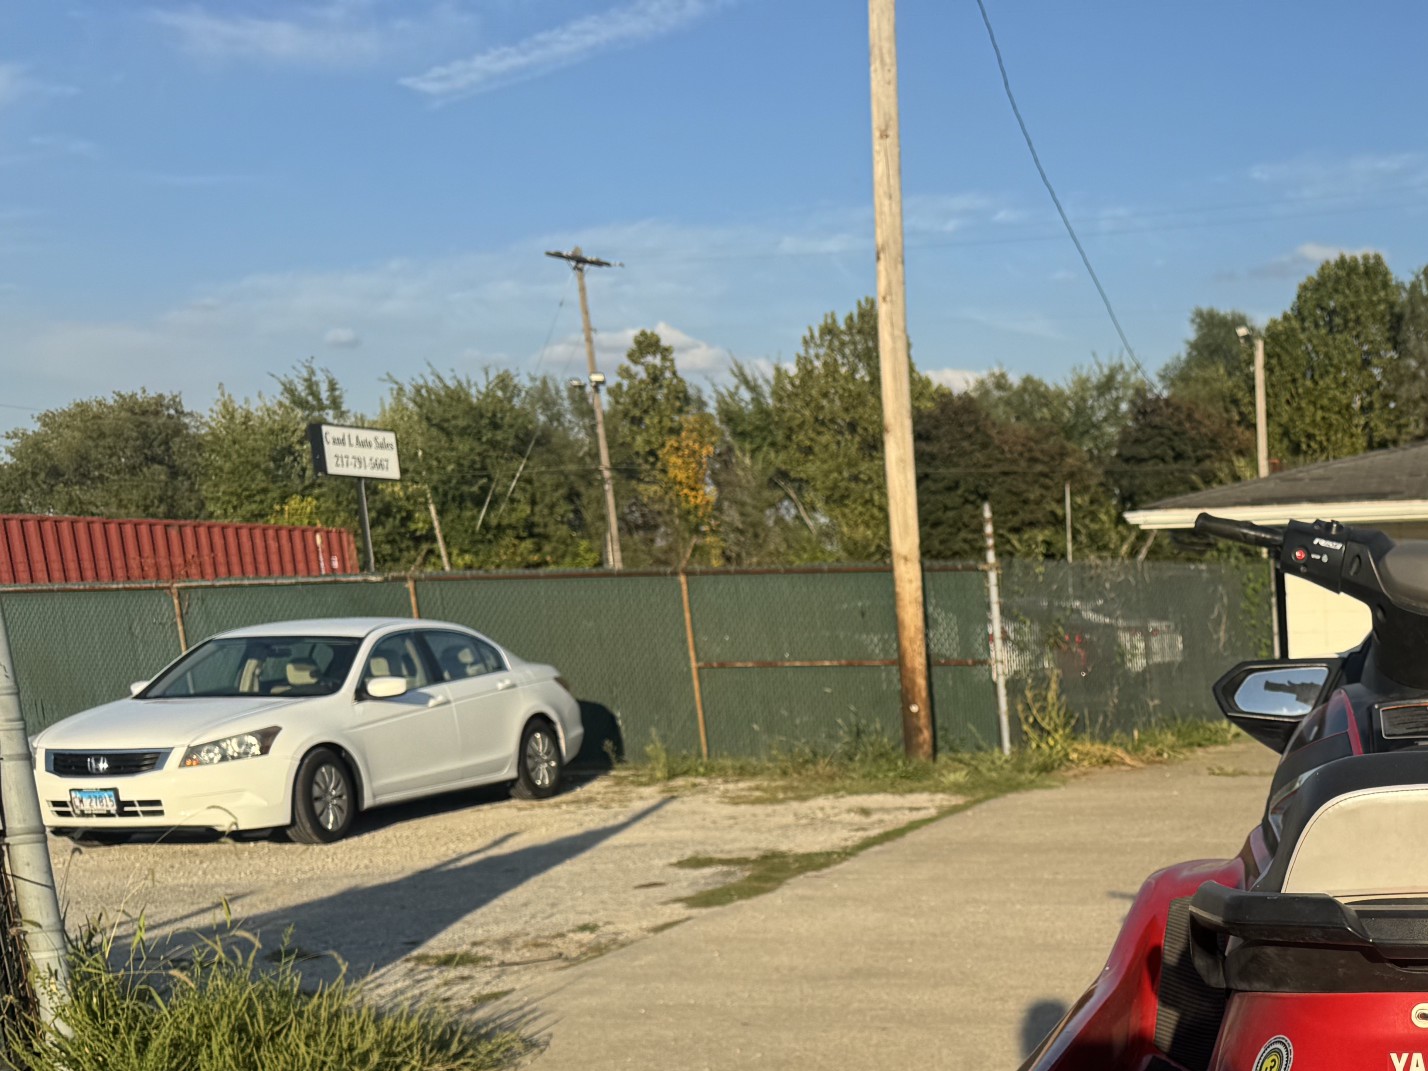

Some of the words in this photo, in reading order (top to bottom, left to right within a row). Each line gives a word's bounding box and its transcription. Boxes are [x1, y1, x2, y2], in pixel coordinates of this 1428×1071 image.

[325, 432, 330, 445] C
[332, 433, 346, 447] and
[348, 433, 355, 447] L
[356, 435, 373, 449] Auto
[375, 436, 394, 451] Sales
